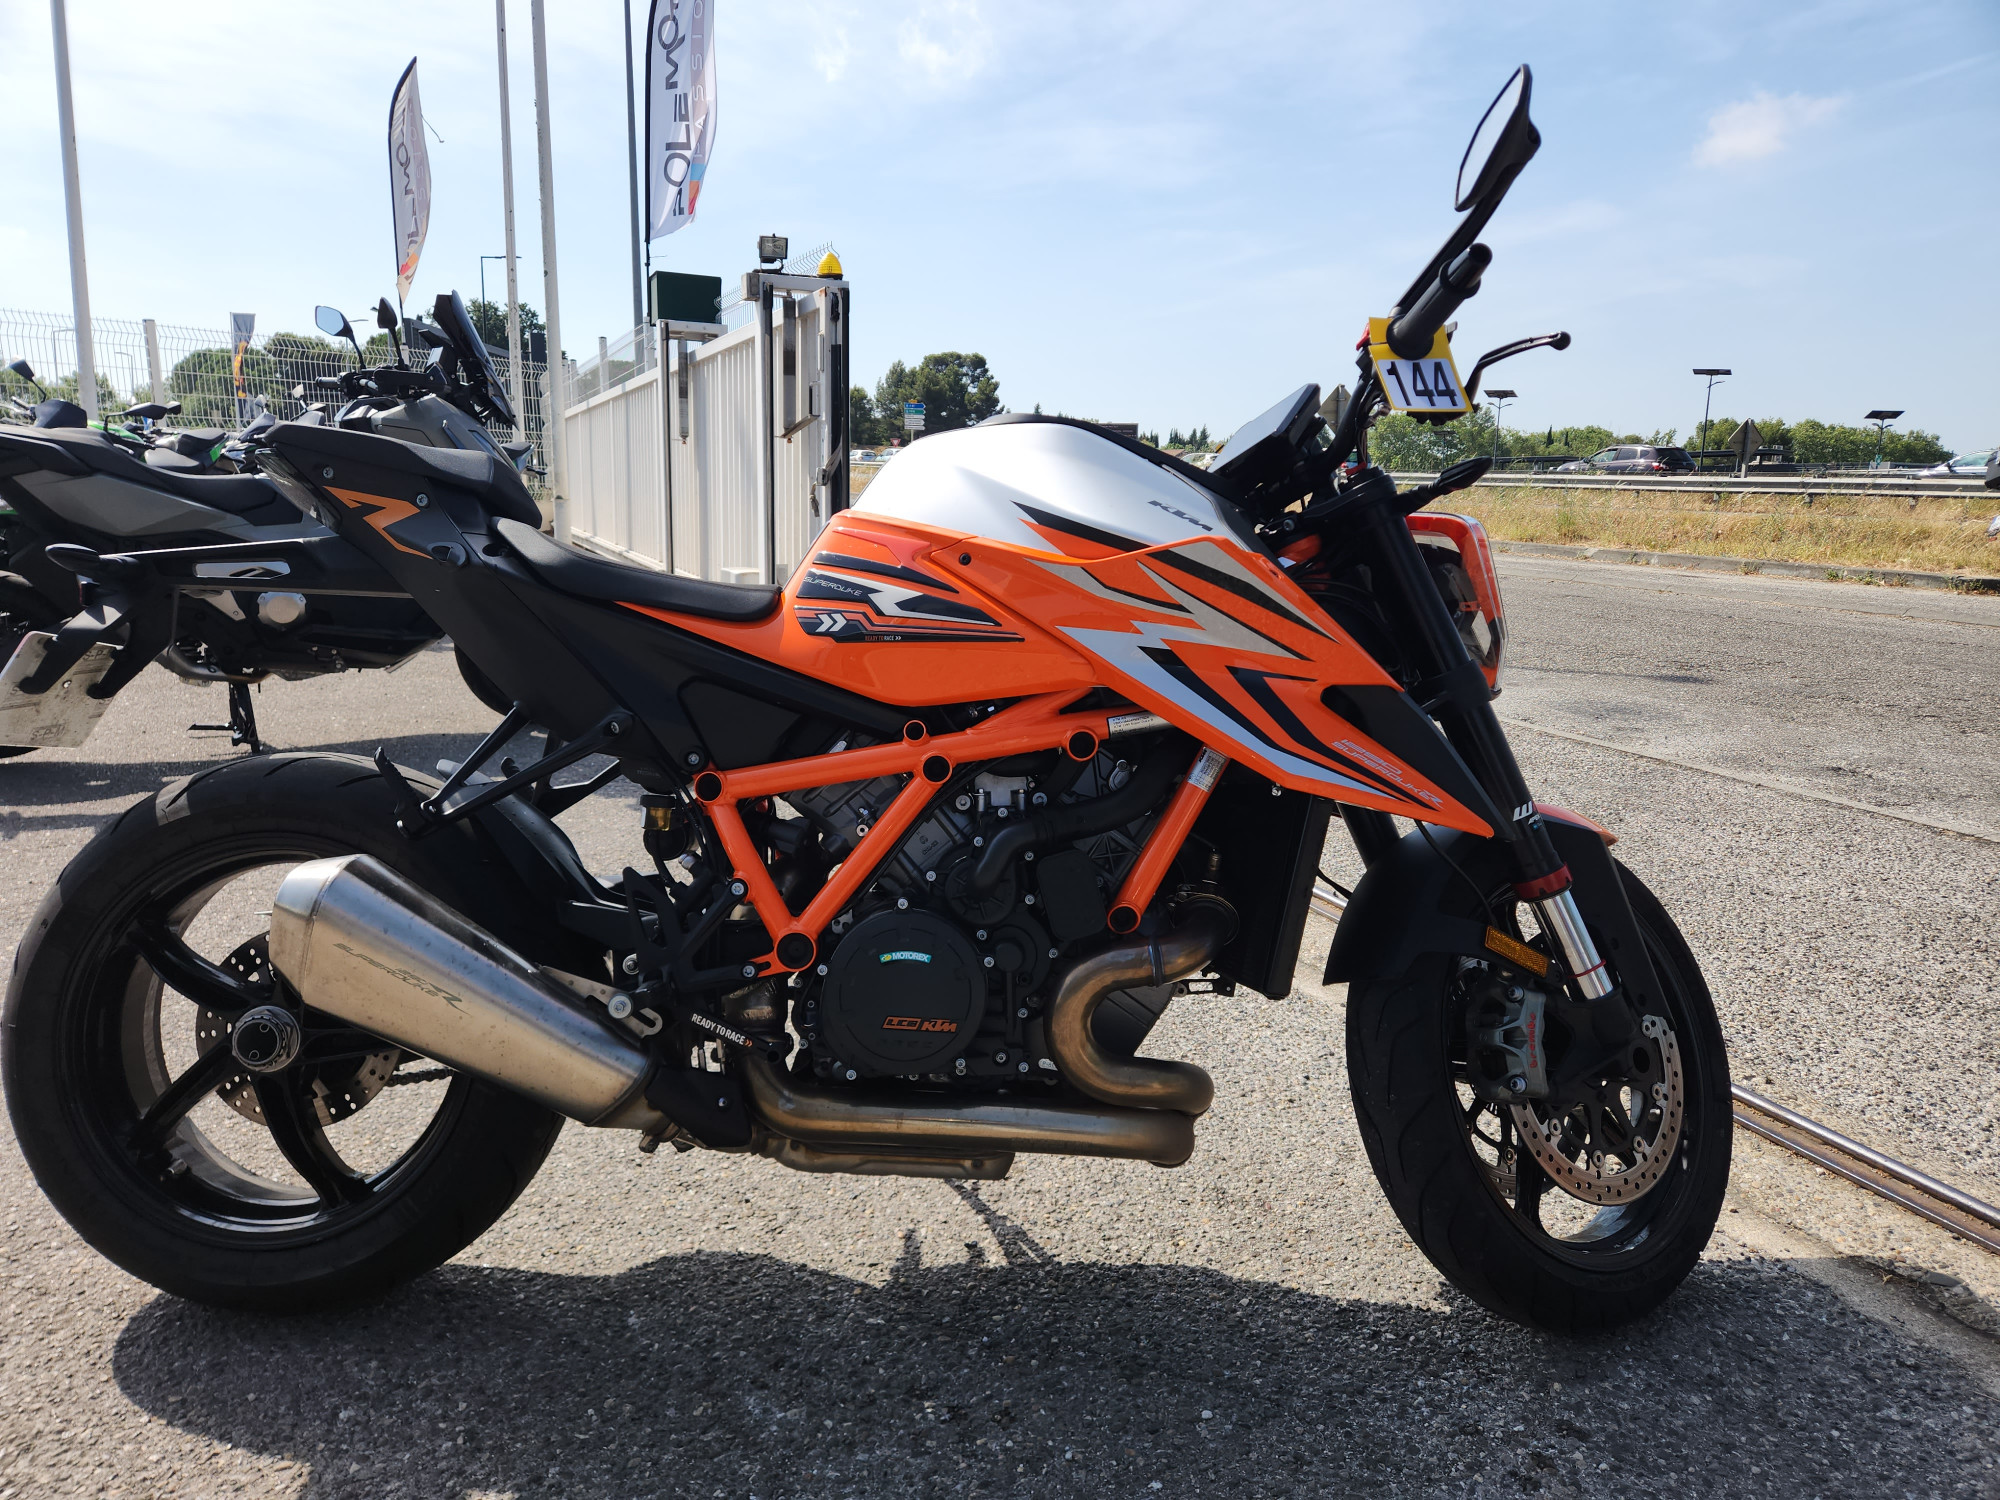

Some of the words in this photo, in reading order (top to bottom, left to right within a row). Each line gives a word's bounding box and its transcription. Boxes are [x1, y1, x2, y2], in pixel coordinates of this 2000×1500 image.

[1387, 360, 1458, 407] 144
[892, 951, 929, 963] MOTOREX
[691, 1013, 716, 1031] READY
[716, 1024, 726, 1036] TO
[725, 1029, 746, 1046] RACE
[920, 1018, 957, 1033] KTM
[1526, 1012, 1538, 1069] brembo
